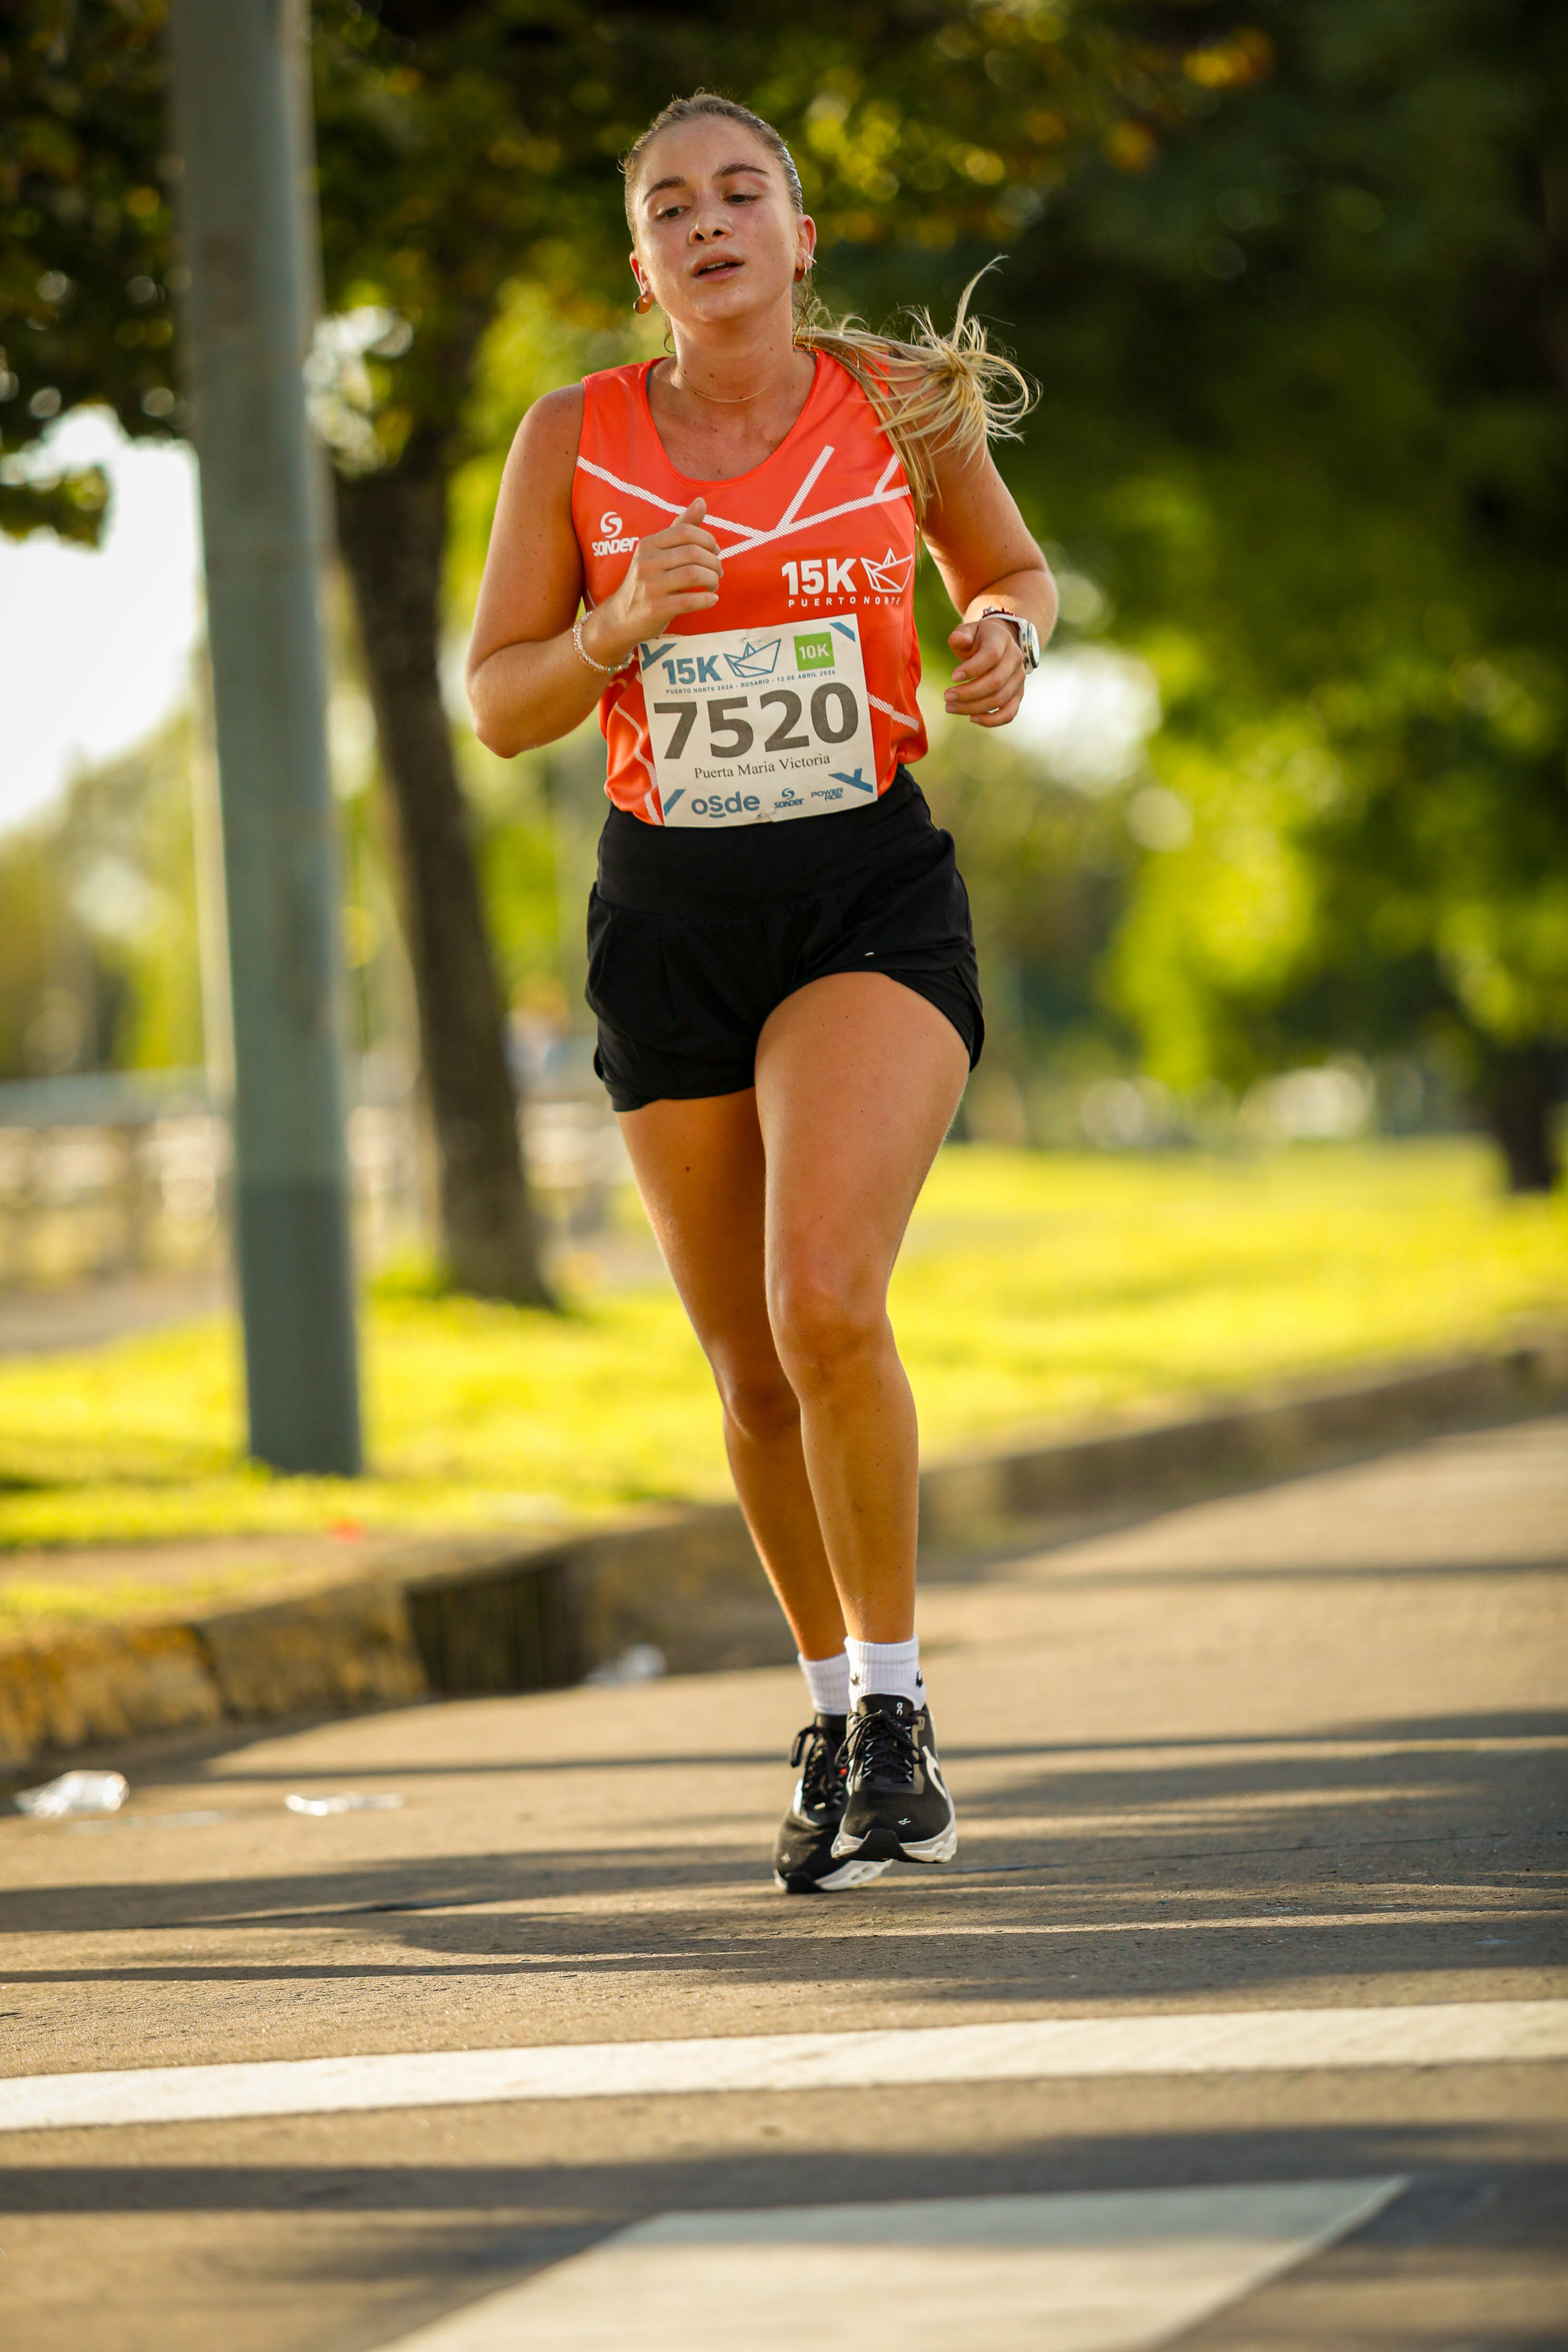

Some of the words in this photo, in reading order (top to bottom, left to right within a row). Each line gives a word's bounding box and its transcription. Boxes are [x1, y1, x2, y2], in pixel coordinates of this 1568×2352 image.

[781, 558, 857, 595] 15K
[788, 596, 856, 607] PUERTO
[864, 596, 900, 605] NORTE
[799, 643, 830, 660] 10K
[662, 654, 722, 685] 15K
[740, 678, 769, 688] ROSARIO
[653, 682, 859, 759] 7520
[694, 767, 734, 779] Puerta
[737, 761, 776, 776] Maria
[779, 753, 831, 770] Victoria
[691, 790, 760, 816] osde
[811, 787, 844, 798] POWER
